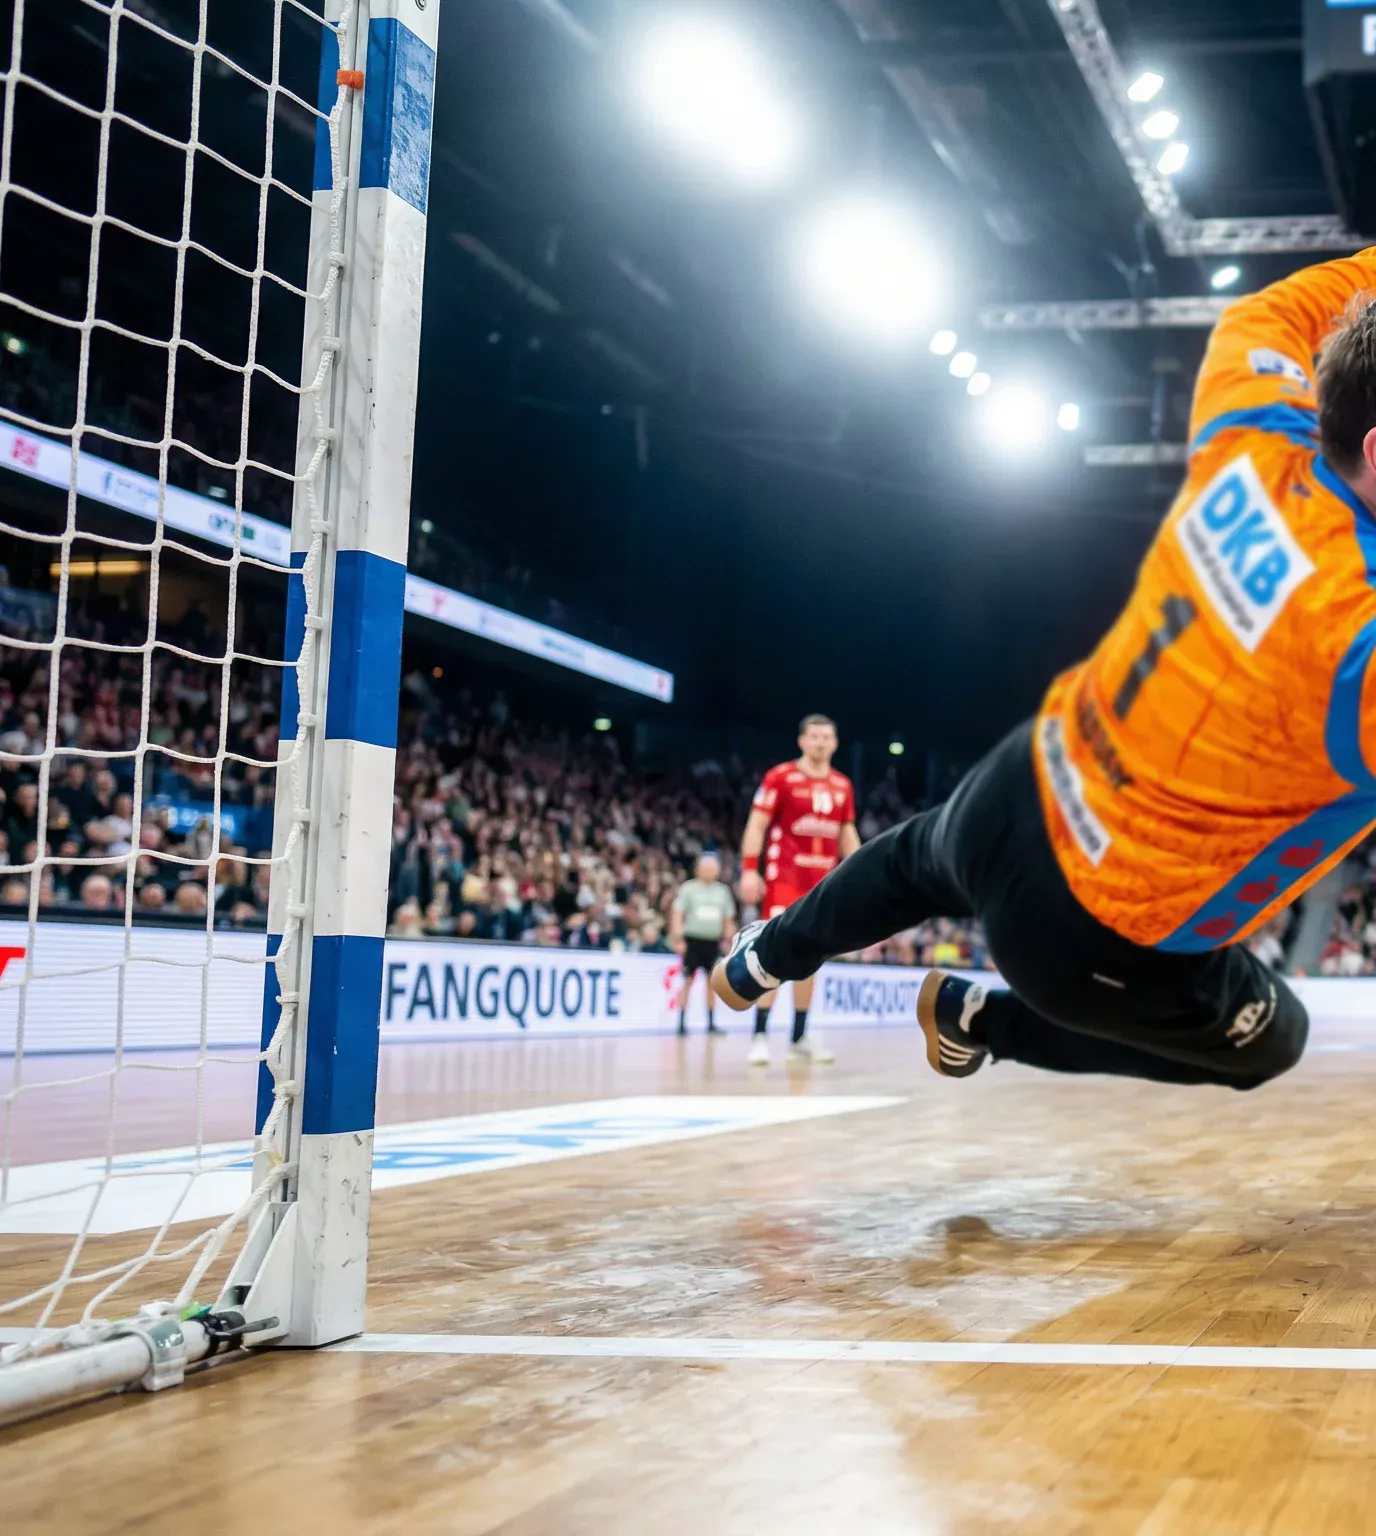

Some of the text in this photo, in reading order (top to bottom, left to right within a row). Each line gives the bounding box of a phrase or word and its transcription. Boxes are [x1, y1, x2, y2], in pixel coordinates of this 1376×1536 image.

[1201, 472, 1290, 607] DKB
[1113, 592, 1197, 721] 1
[385, 962, 621, 1028] FANGQUOTE
[824, 977, 921, 1015] FANGQUOT
